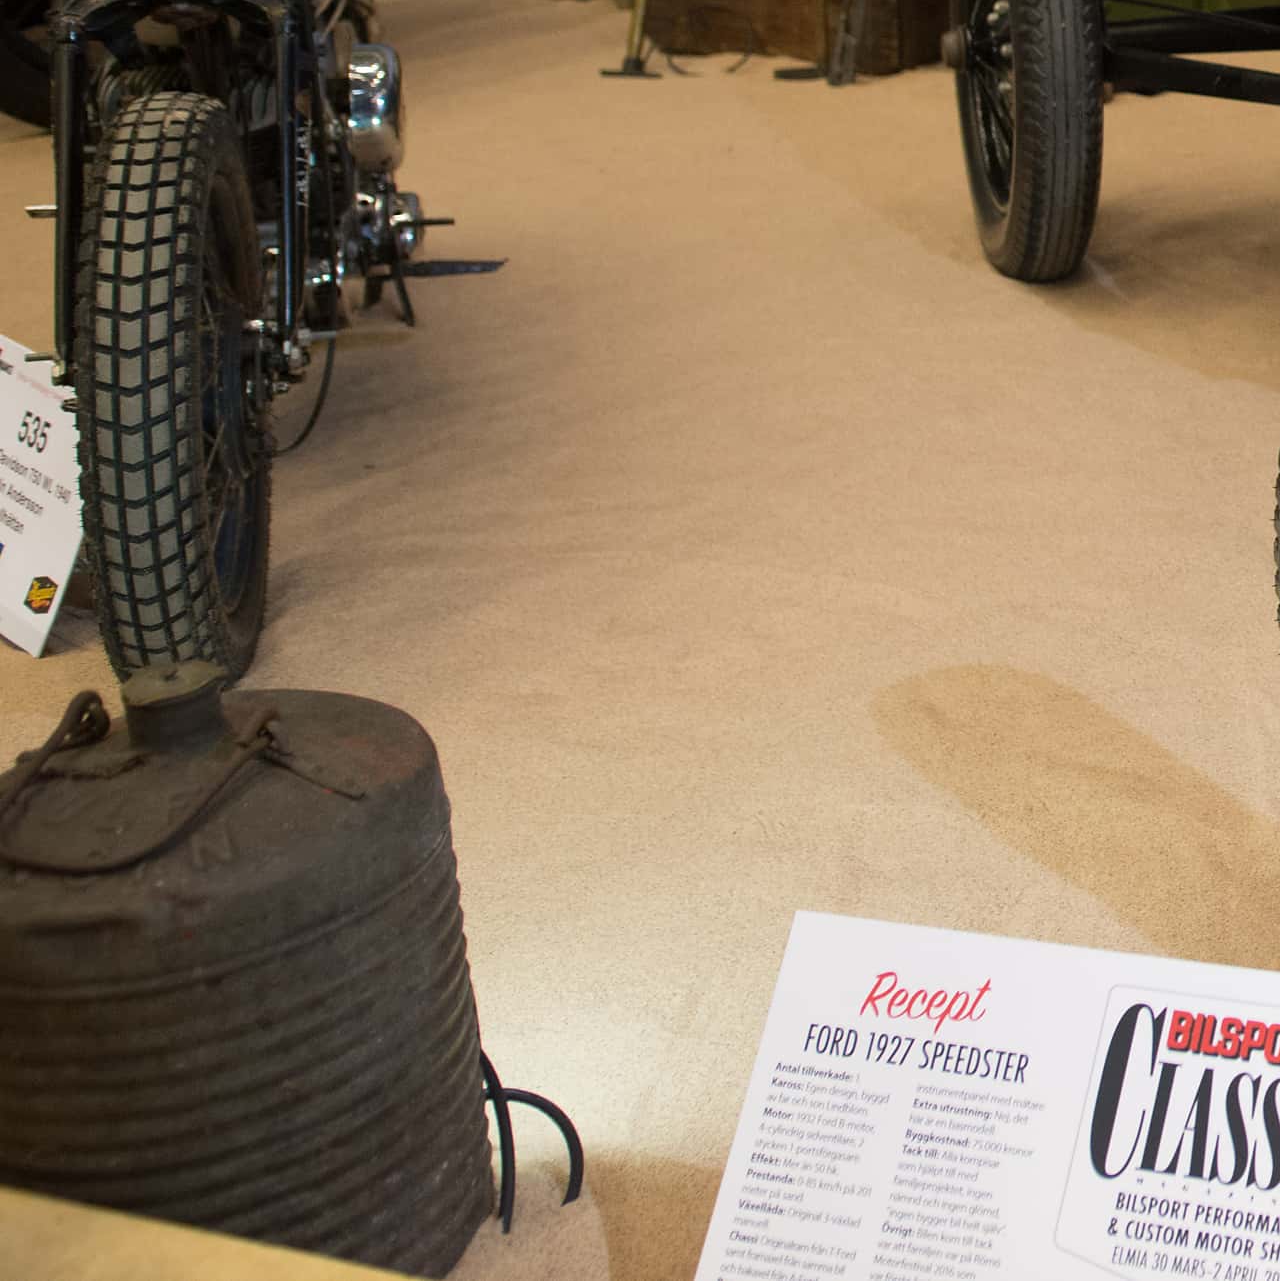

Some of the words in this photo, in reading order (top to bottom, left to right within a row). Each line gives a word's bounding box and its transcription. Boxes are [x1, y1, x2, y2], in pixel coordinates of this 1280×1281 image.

[18, 410, 51, 453] 535
[859, 970, 992, 1035] Recept
[776, 1063, 800, 1073] Antal
[803, 1022, 860, 1058] FORD
[865, 1030, 916, 1066] 1927
[917, 1039, 1030, 1084] SPEEDSTER
[1115, 1190, 1192, 1219] BILSPORT
[1107, 1217, 1119, 1237] &
[1125, 1219, 1190, 1248] CUSTOM
[1194, 1231, 1255, 1258] MOTOR
[1111, 1245, 1148, 1269] ELMIA
[1151, 1251, 1168, 1271] 30
